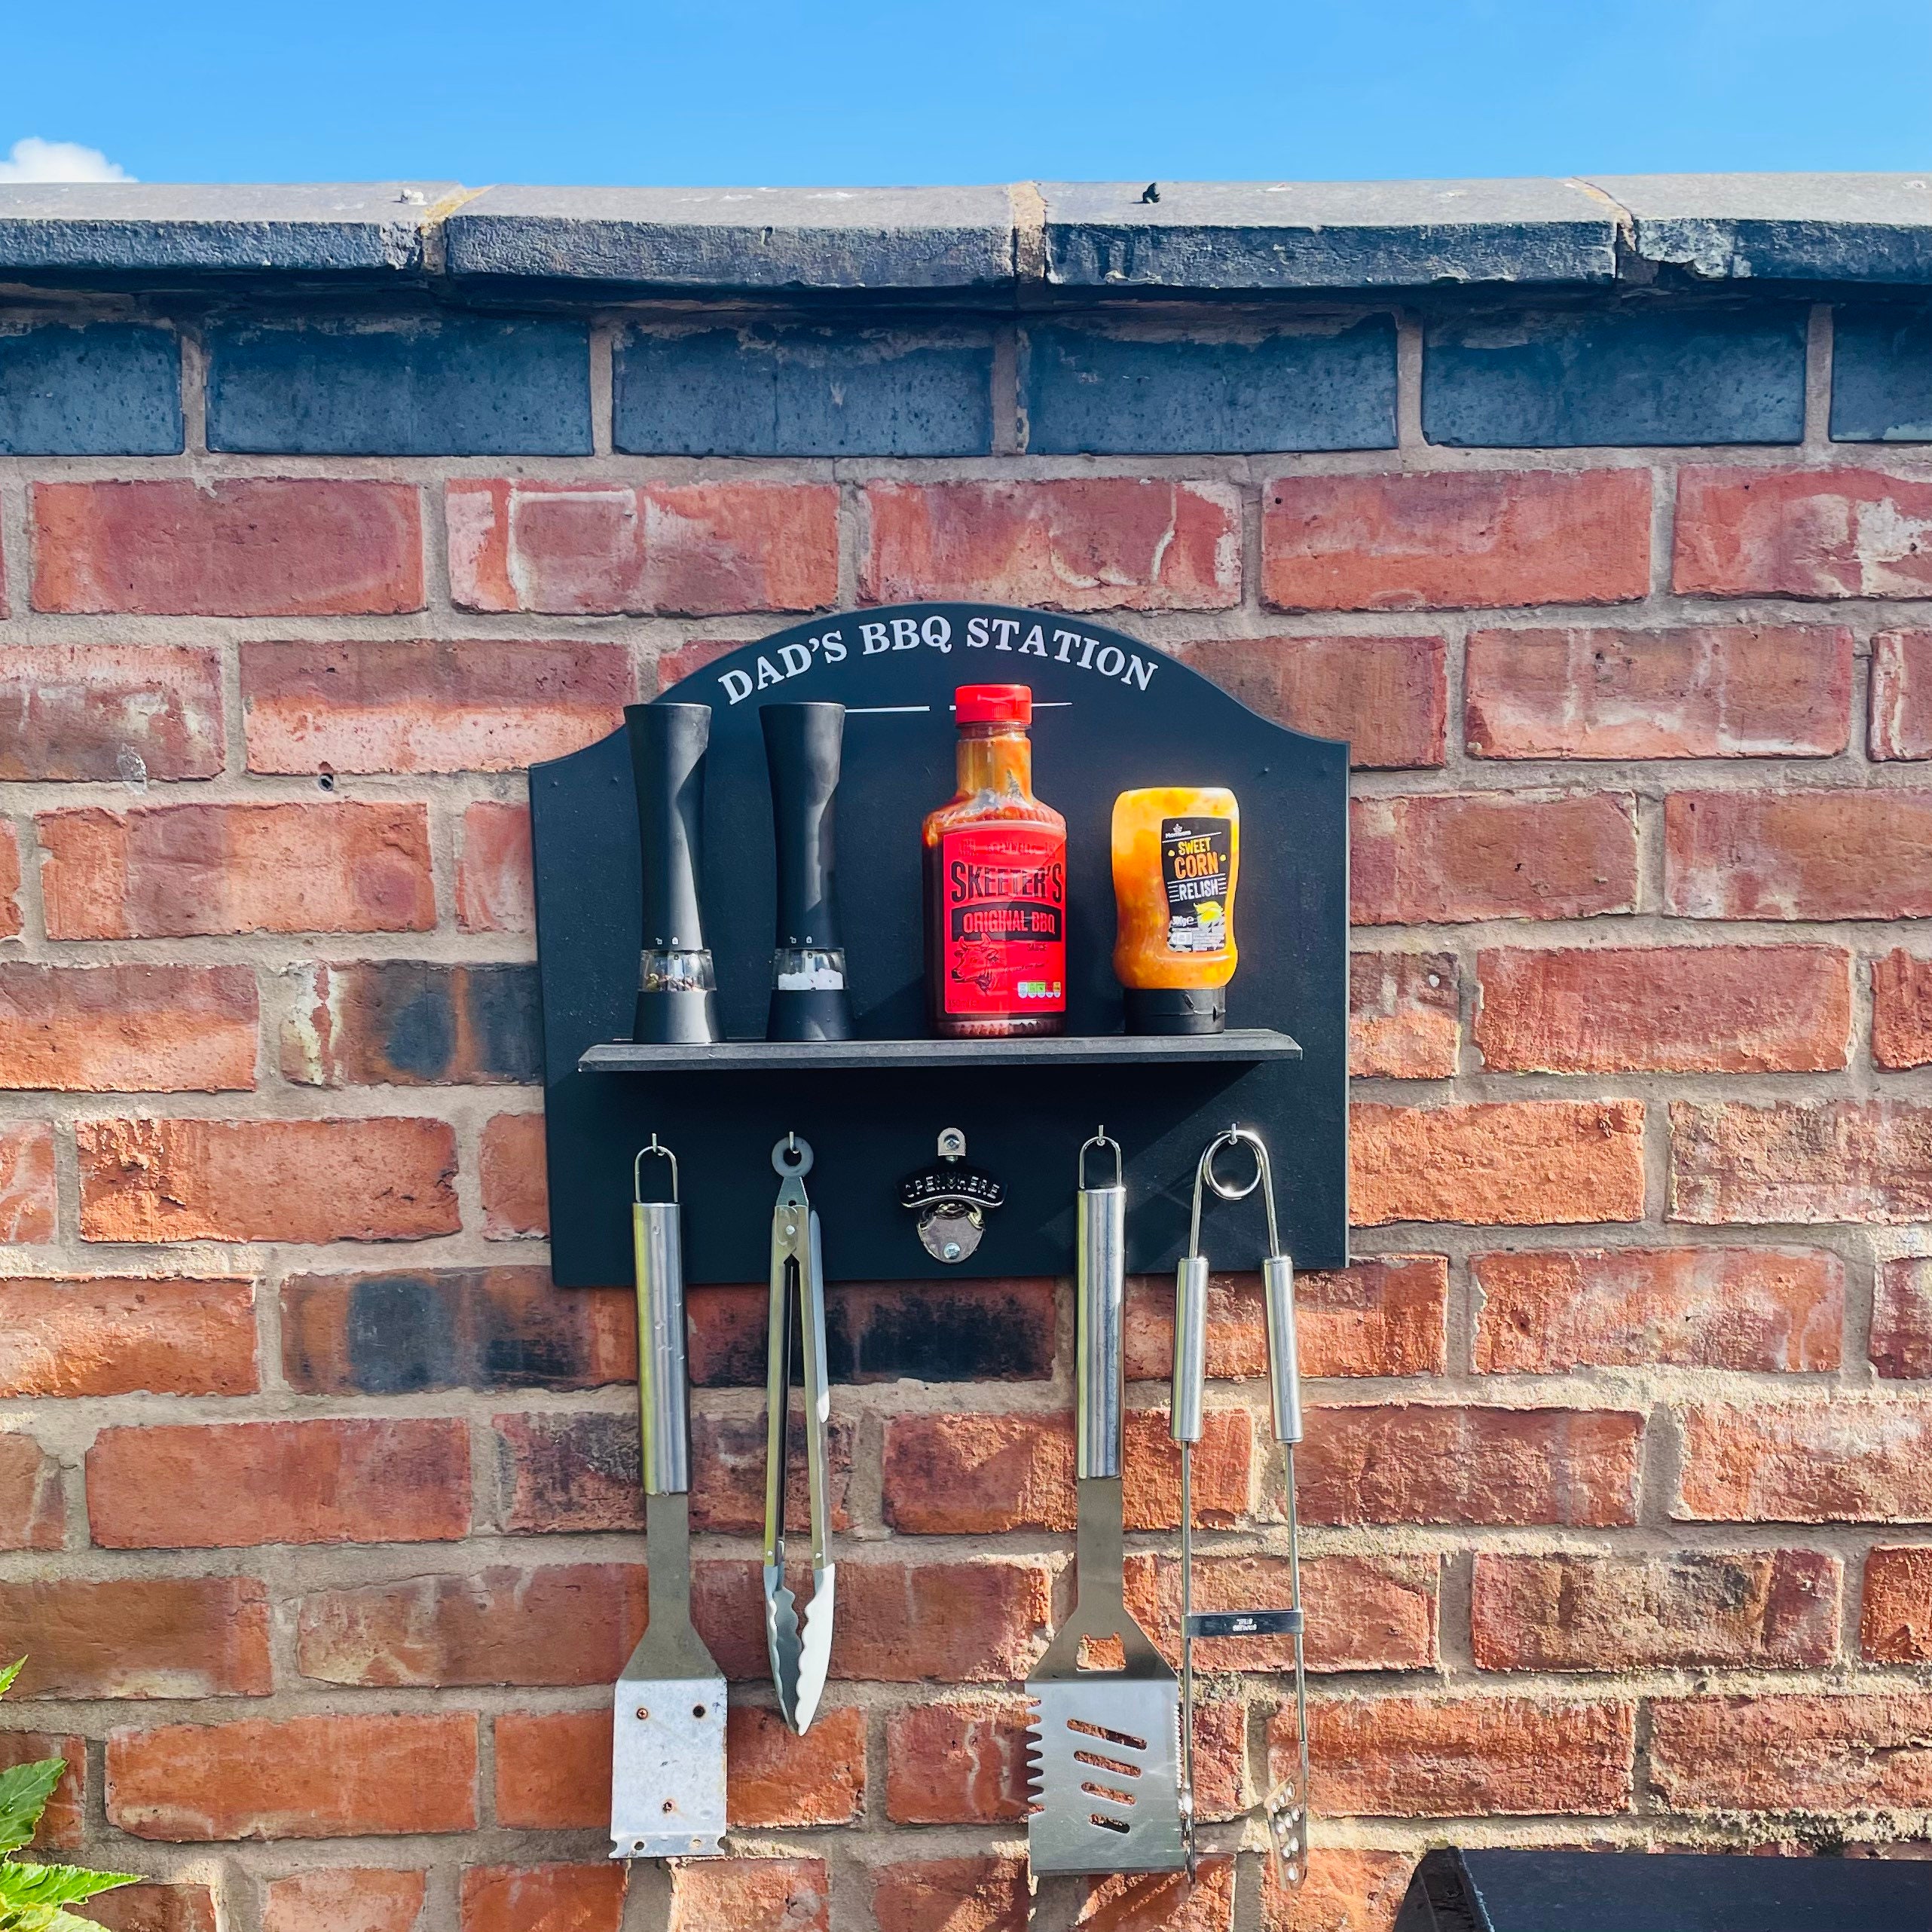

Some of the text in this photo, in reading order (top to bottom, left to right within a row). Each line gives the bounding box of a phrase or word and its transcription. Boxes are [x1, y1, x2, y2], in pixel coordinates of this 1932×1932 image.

[718, 615, 1160, 705] DAD'S BBQ STATION
[1178, 836, 1212, 856] SWEET
[1174, 853, 1220, 879] CORN
[951, 861, 1062, 903] SKEETER'S
[1178, 878, 1219, 901] RELISH
[963, 909, 1056, 934] ORIGINAL BBQ
